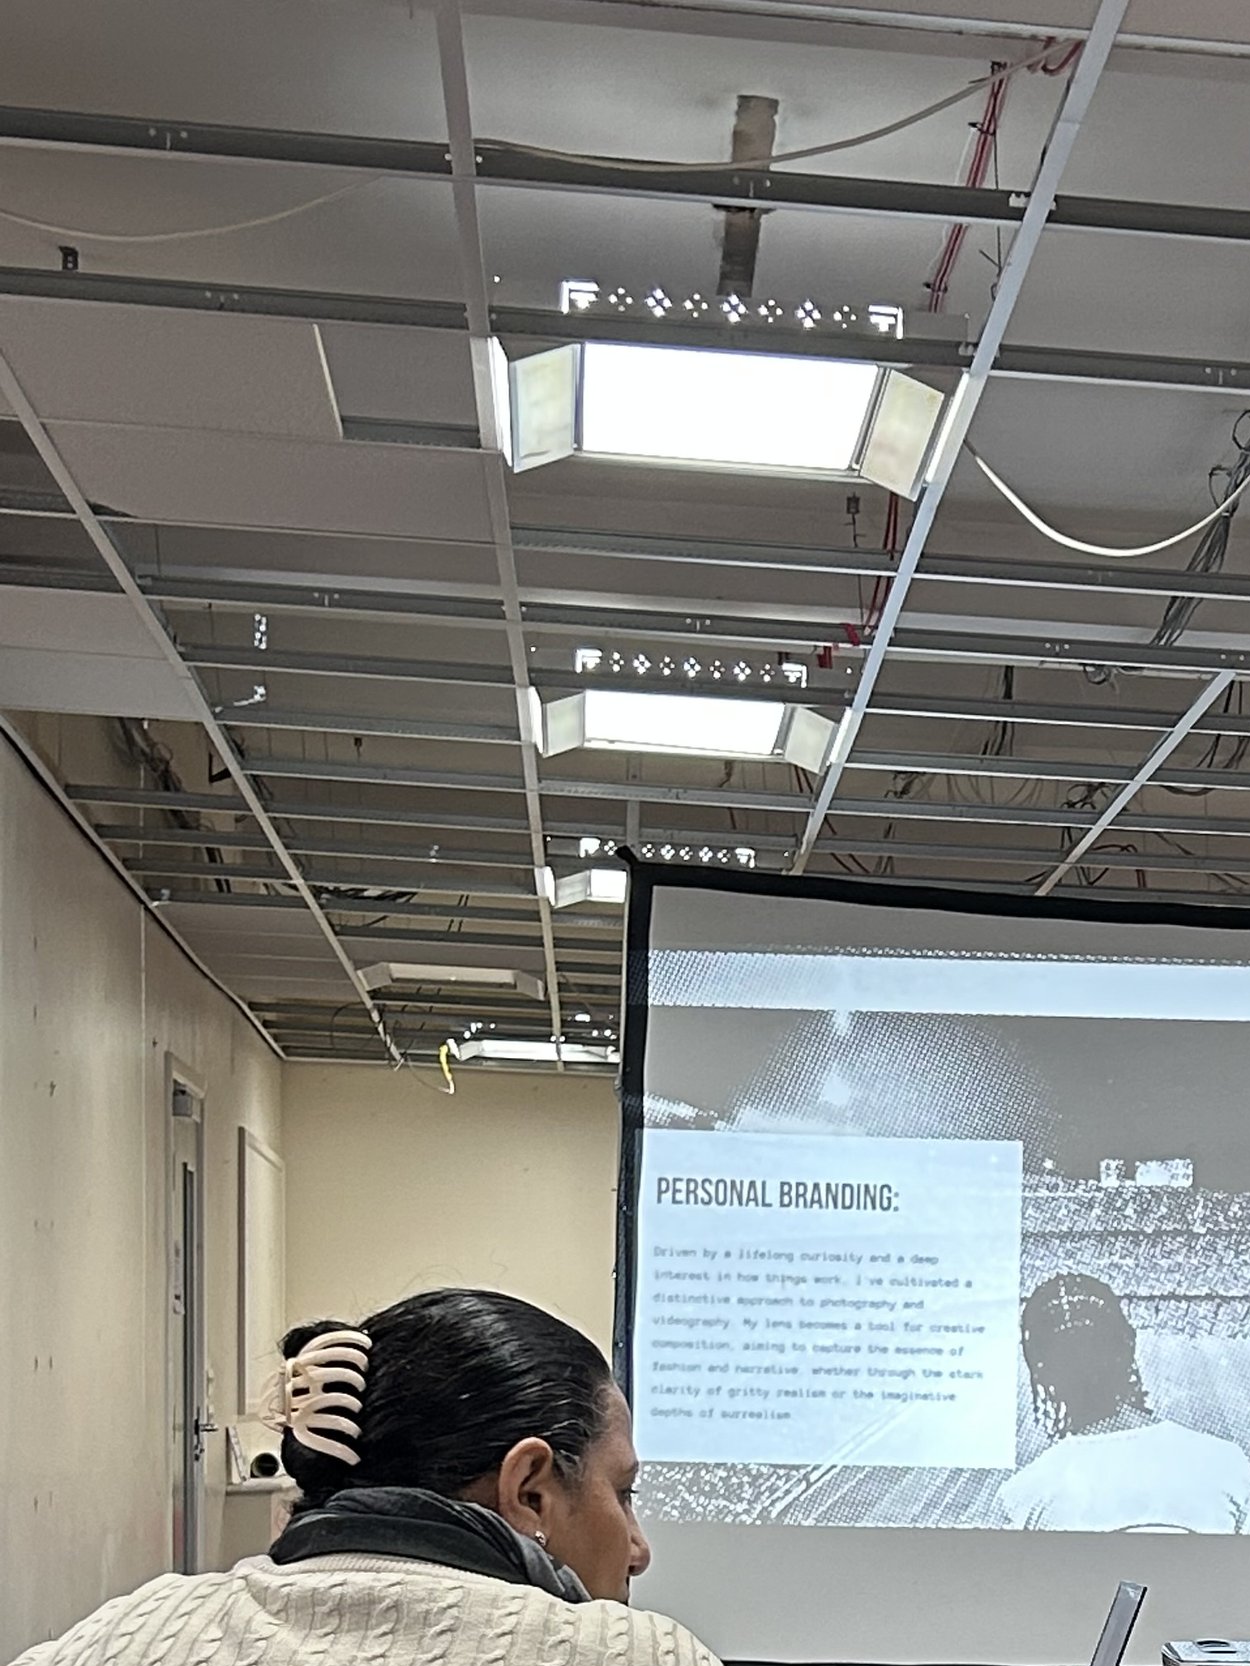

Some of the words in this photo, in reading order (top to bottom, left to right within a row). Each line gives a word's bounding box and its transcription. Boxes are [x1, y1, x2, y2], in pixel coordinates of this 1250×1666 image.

[657, 1177, 773, 1207] PERSONAL
[779, 1181, 899, 1212] BRANDING:
[653, 1246, 697, 1258] Driven
[703, 1248, 717, 1261] by
[724, 1250, 731, 1258] a
[739, 1248, 794, 1262] lifelong
[800, 1252, 863, 1264] curiosity
[870, 1253, 891, 1262] and
[897, 1255, 905, 1263] a
[910, 1254, 939, 1265] deep
[718, 1272, 731, 1281] in
[737, 1272, 758, 1282] how
[766, 1273, 807, 1286] things
[889, 1277, 959, 1287] cultivated
[965, 1280, 972, 1288] a
[653, 1292, 730, 1304] distinctive
[800, 1296, 814, 1306] to
[820, 1298, 897, 1311] photography
[903, 1301, 924, 1309] and
[743, 1317, 758, 1330] My
[766, 1318, 792, 1329] lens
[800, 1321, 847, 1330] becomes
[854, 1322, 861, 1330] a
[868, 1322, 895, 1331] tool
[904, 1322, 923, 1332] for
[929, 1324, 985, 1333] creative
[743, 1341, 785, 1353] aiming
[792, 1342, 806, 1351] to
[812, 1343, 861, 1354] capture
[868, 1344, 888, 1354] the
[950, 1346, 964, 1356] of
[652, 1360, 701, 1372] fashion
[708, 1363, 729, 1373] and
[812, 1366, 860, 1376] whether
[922, 1369, 943, 1378] the
[651, 1384, 700, 1397] clarity
[707, 1386, 722, 1396] of
[728, 1387, 770, 1399] gritty
[777, 1388, 826, 1398] realism
[832, 1390, 846, 1398] or
[853, 1390, 874, 1398] the
[881, 1391, 956, 1403] imaginative
[699, 1409, 714, 1418] of
